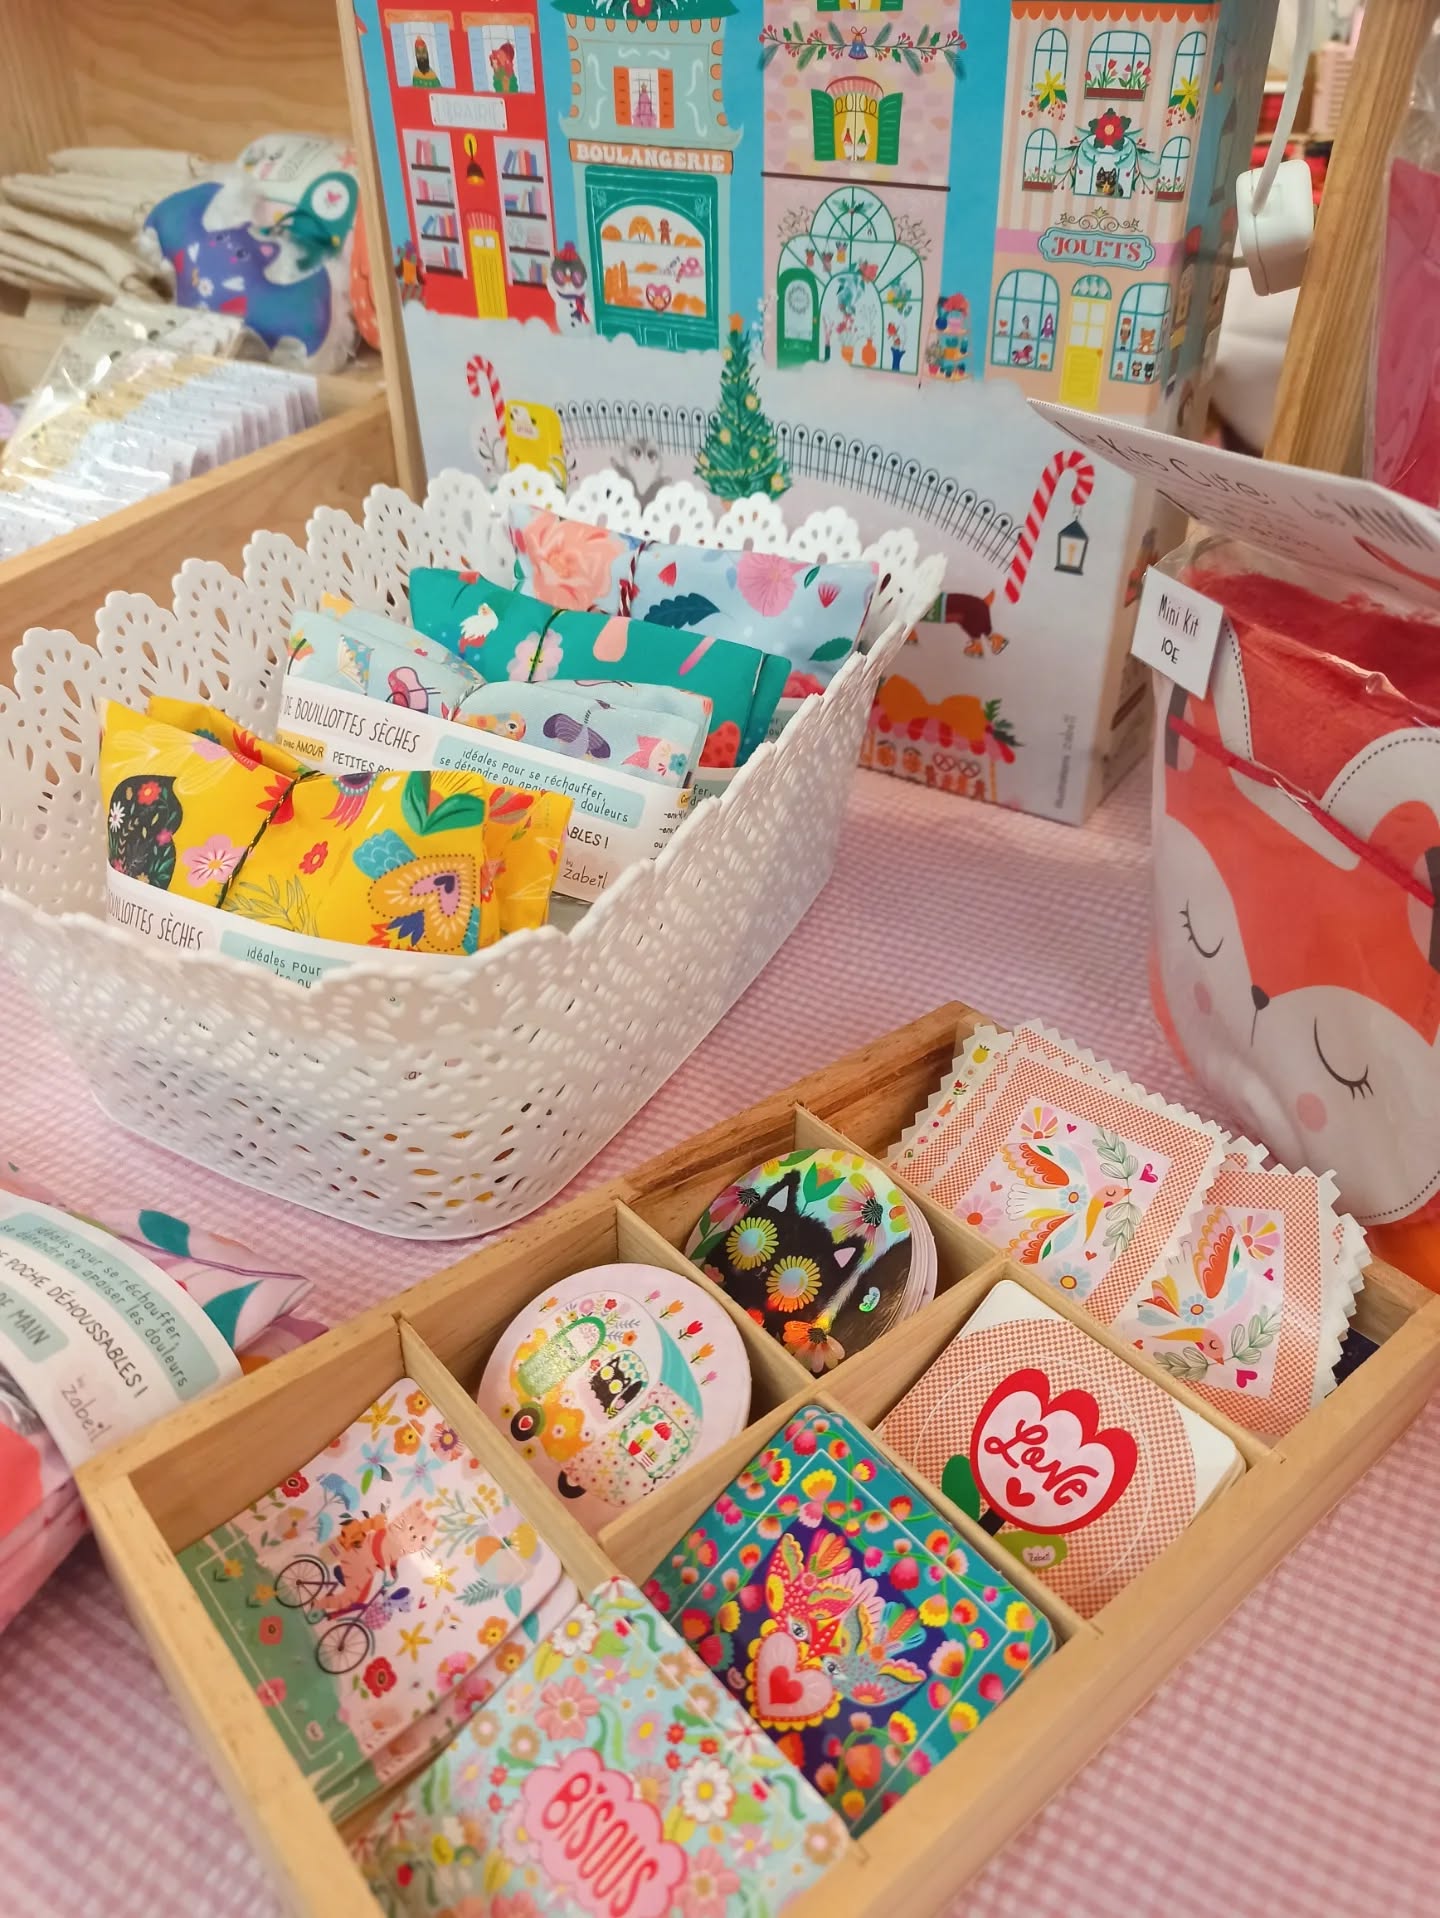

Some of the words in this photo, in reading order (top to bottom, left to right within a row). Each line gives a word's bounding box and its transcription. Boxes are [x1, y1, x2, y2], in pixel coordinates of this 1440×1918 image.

[576, 143, 725, 172] BOULANGERIE
[1051, 236, 1142, 262] JOUETS
[1158, 593, 1181, 627] Mini
[1182, 607, 1200, 637] Kit
[295, 697, 366, 737] BOUILLOTTES
[369, 718, 421, 753] SÈCHES
[296, 740, 325, 758] AMOUR
[332, 751, 375, 773] PETITES
[440, 756, 451, 767] se
[502, 776, 514, 787] ou
[462, 747, 498, 768] idéales
[502, 762, 525, 776] pour
[529, 769, 542, 781] se
[544, 774, 607, 803] réchauffer,
[580, 797, 630, 823] douleurs
[156, 912, 204, 950] SÈCHES
[247, 947, 285, 969] idéales
[292, 961, 322, 977] pour
[76, 1247, 103, 1268] pour
[103, 1266, 120, 1279] se
[5, 1257, 52, 1288] POCHE
[47, 1286, 143, 1388] DÉHOUSSABLES
[7, 1308, 51, 1346] MAIN
[64, 1257, 81, 1270] ou
[82, 1269, 127, 1306] apaiser
[125, 1304, 146, 1327] les
[144, 1327, 189, 1388] douleurs
